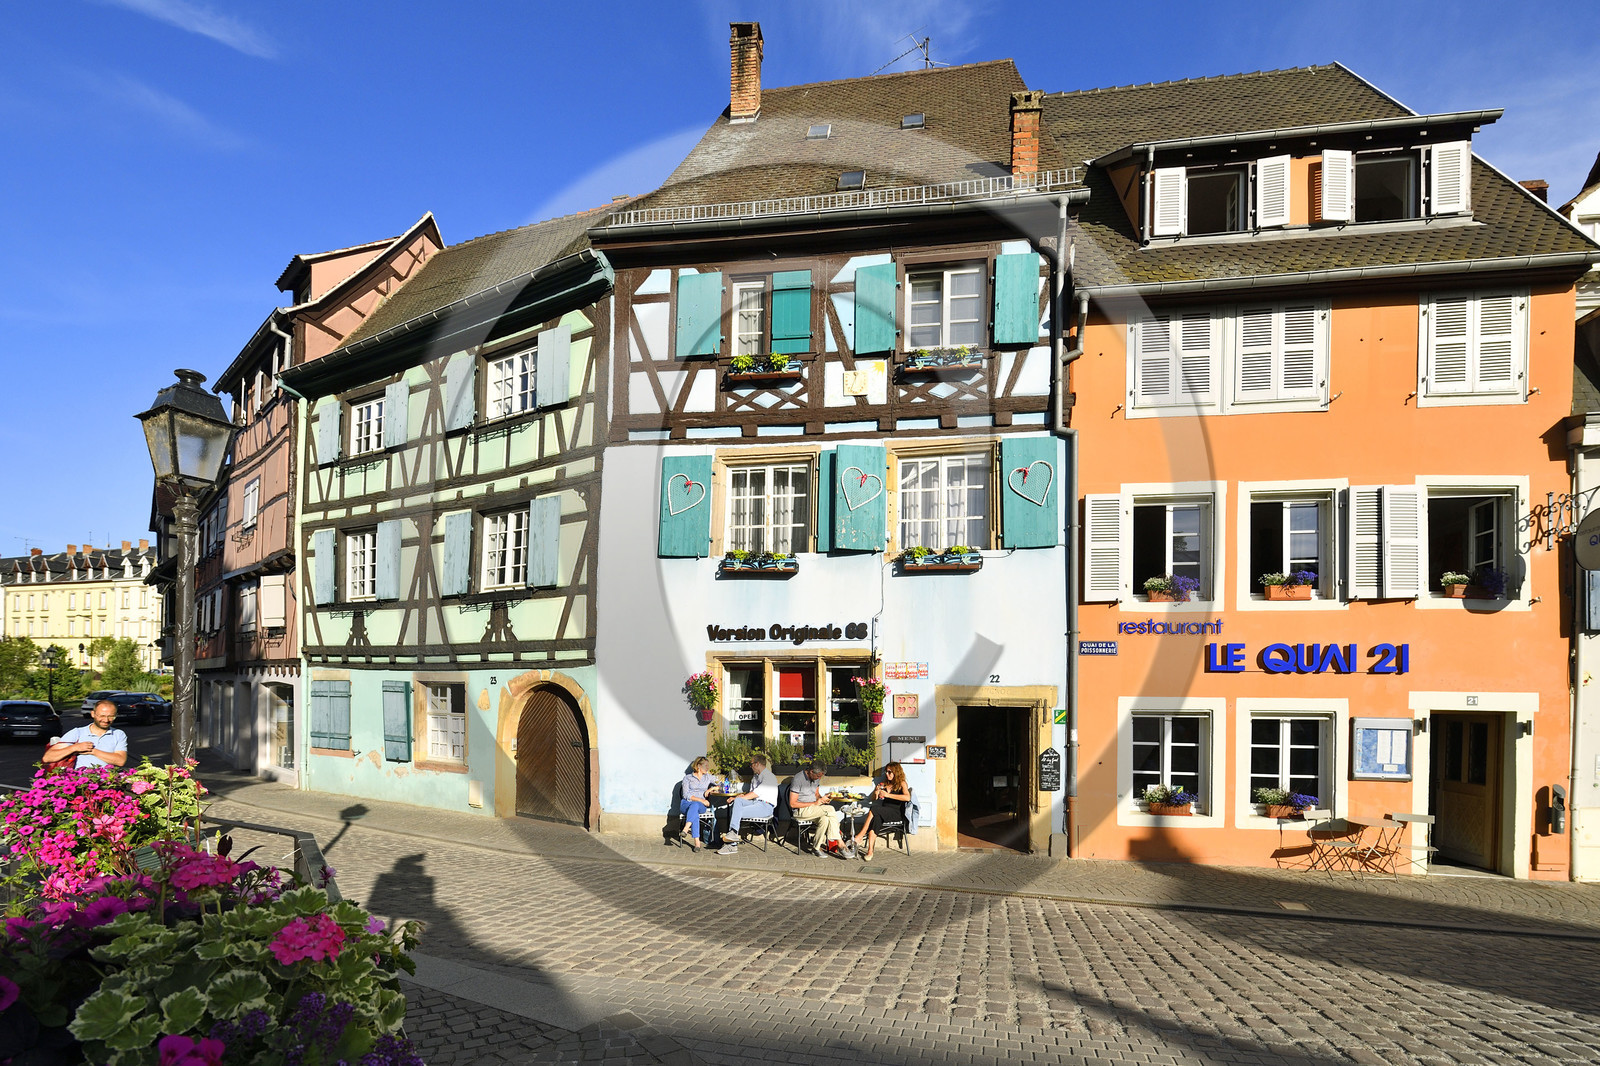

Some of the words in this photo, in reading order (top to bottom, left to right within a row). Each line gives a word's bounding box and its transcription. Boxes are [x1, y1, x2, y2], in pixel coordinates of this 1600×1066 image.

[707, 624, 766, 641] Version
[769, 624, 842, 645] Originale
[845, 622, 868, 639] 68
[1118, 618, 1224, 635] restaurant
[1209, 642, 1246, 672] LE
[1262, 642, 1358, 673] QUAI
[1373, 642, 1410, 673] 21
[989, 674, 1001, 683] 22
[1467, 696, 1478, 705] 21
